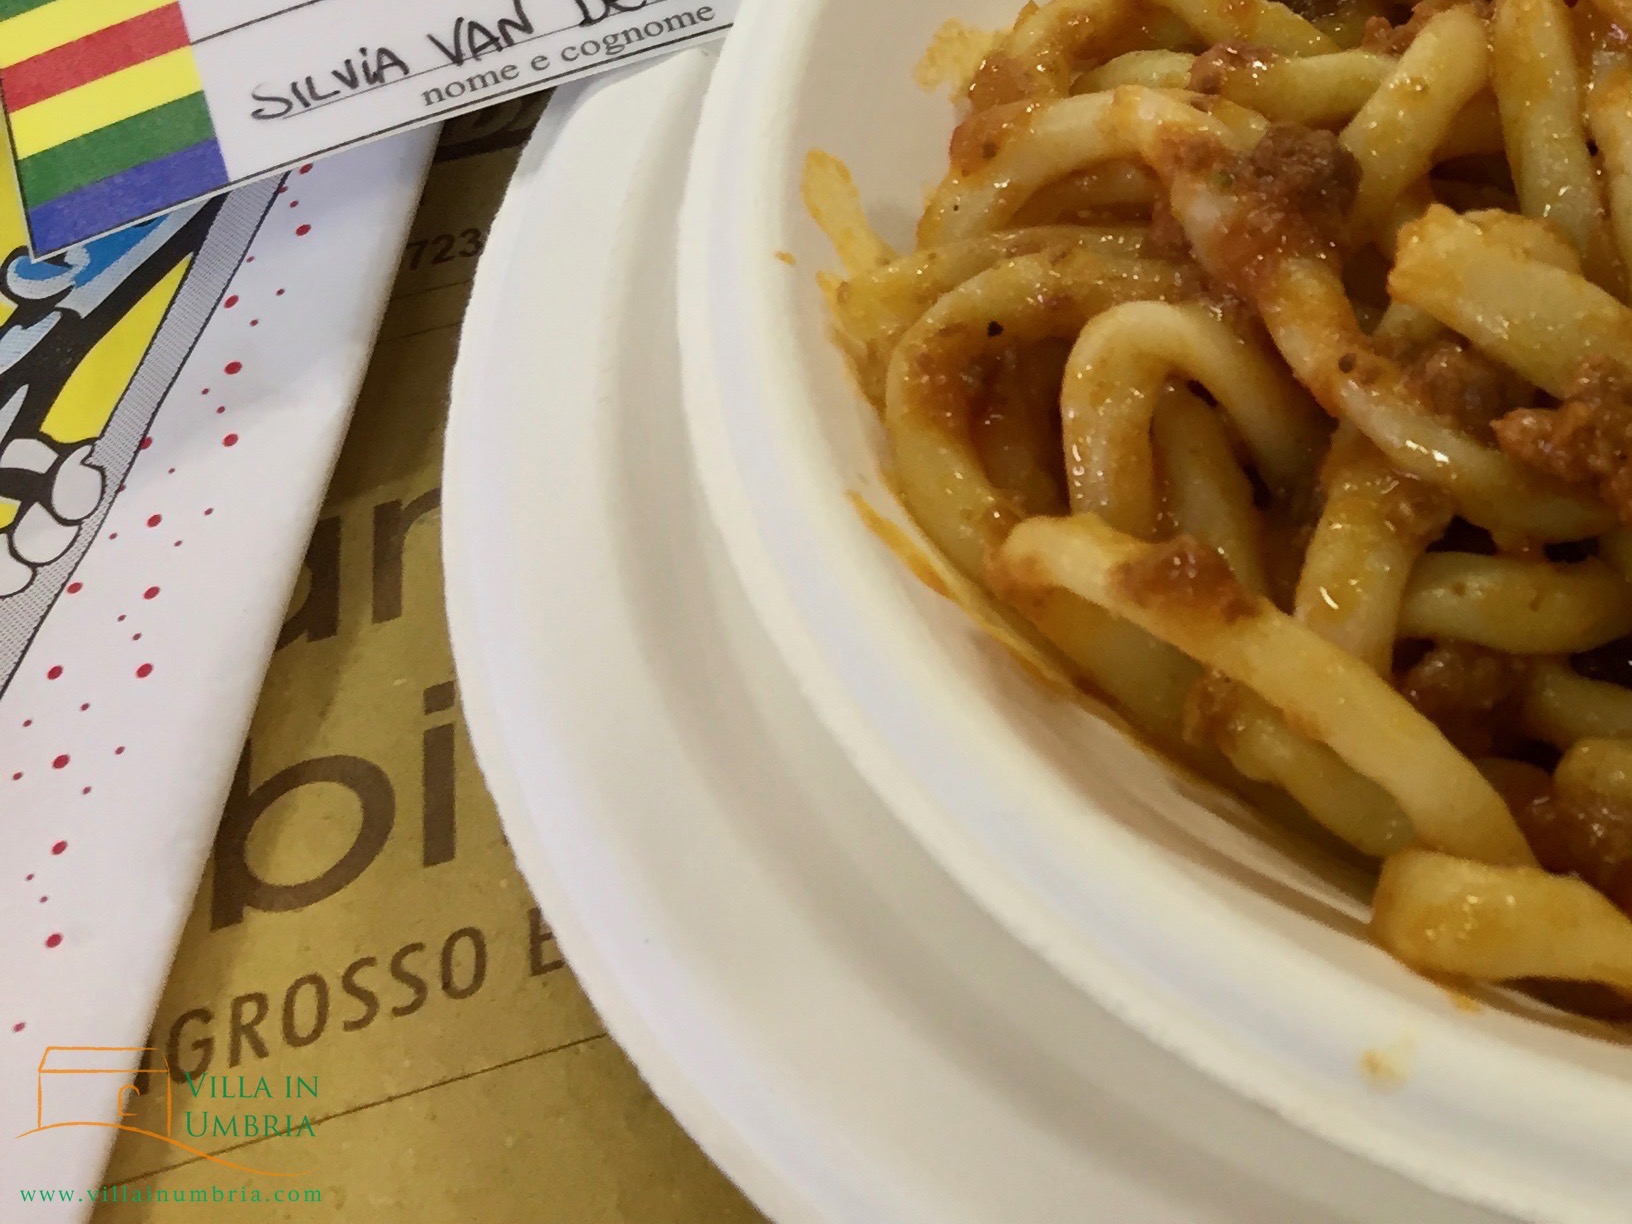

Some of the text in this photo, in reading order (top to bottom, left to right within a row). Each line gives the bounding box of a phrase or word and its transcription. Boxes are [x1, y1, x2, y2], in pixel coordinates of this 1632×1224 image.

[420, 5, 716, 107] nome e cognome
